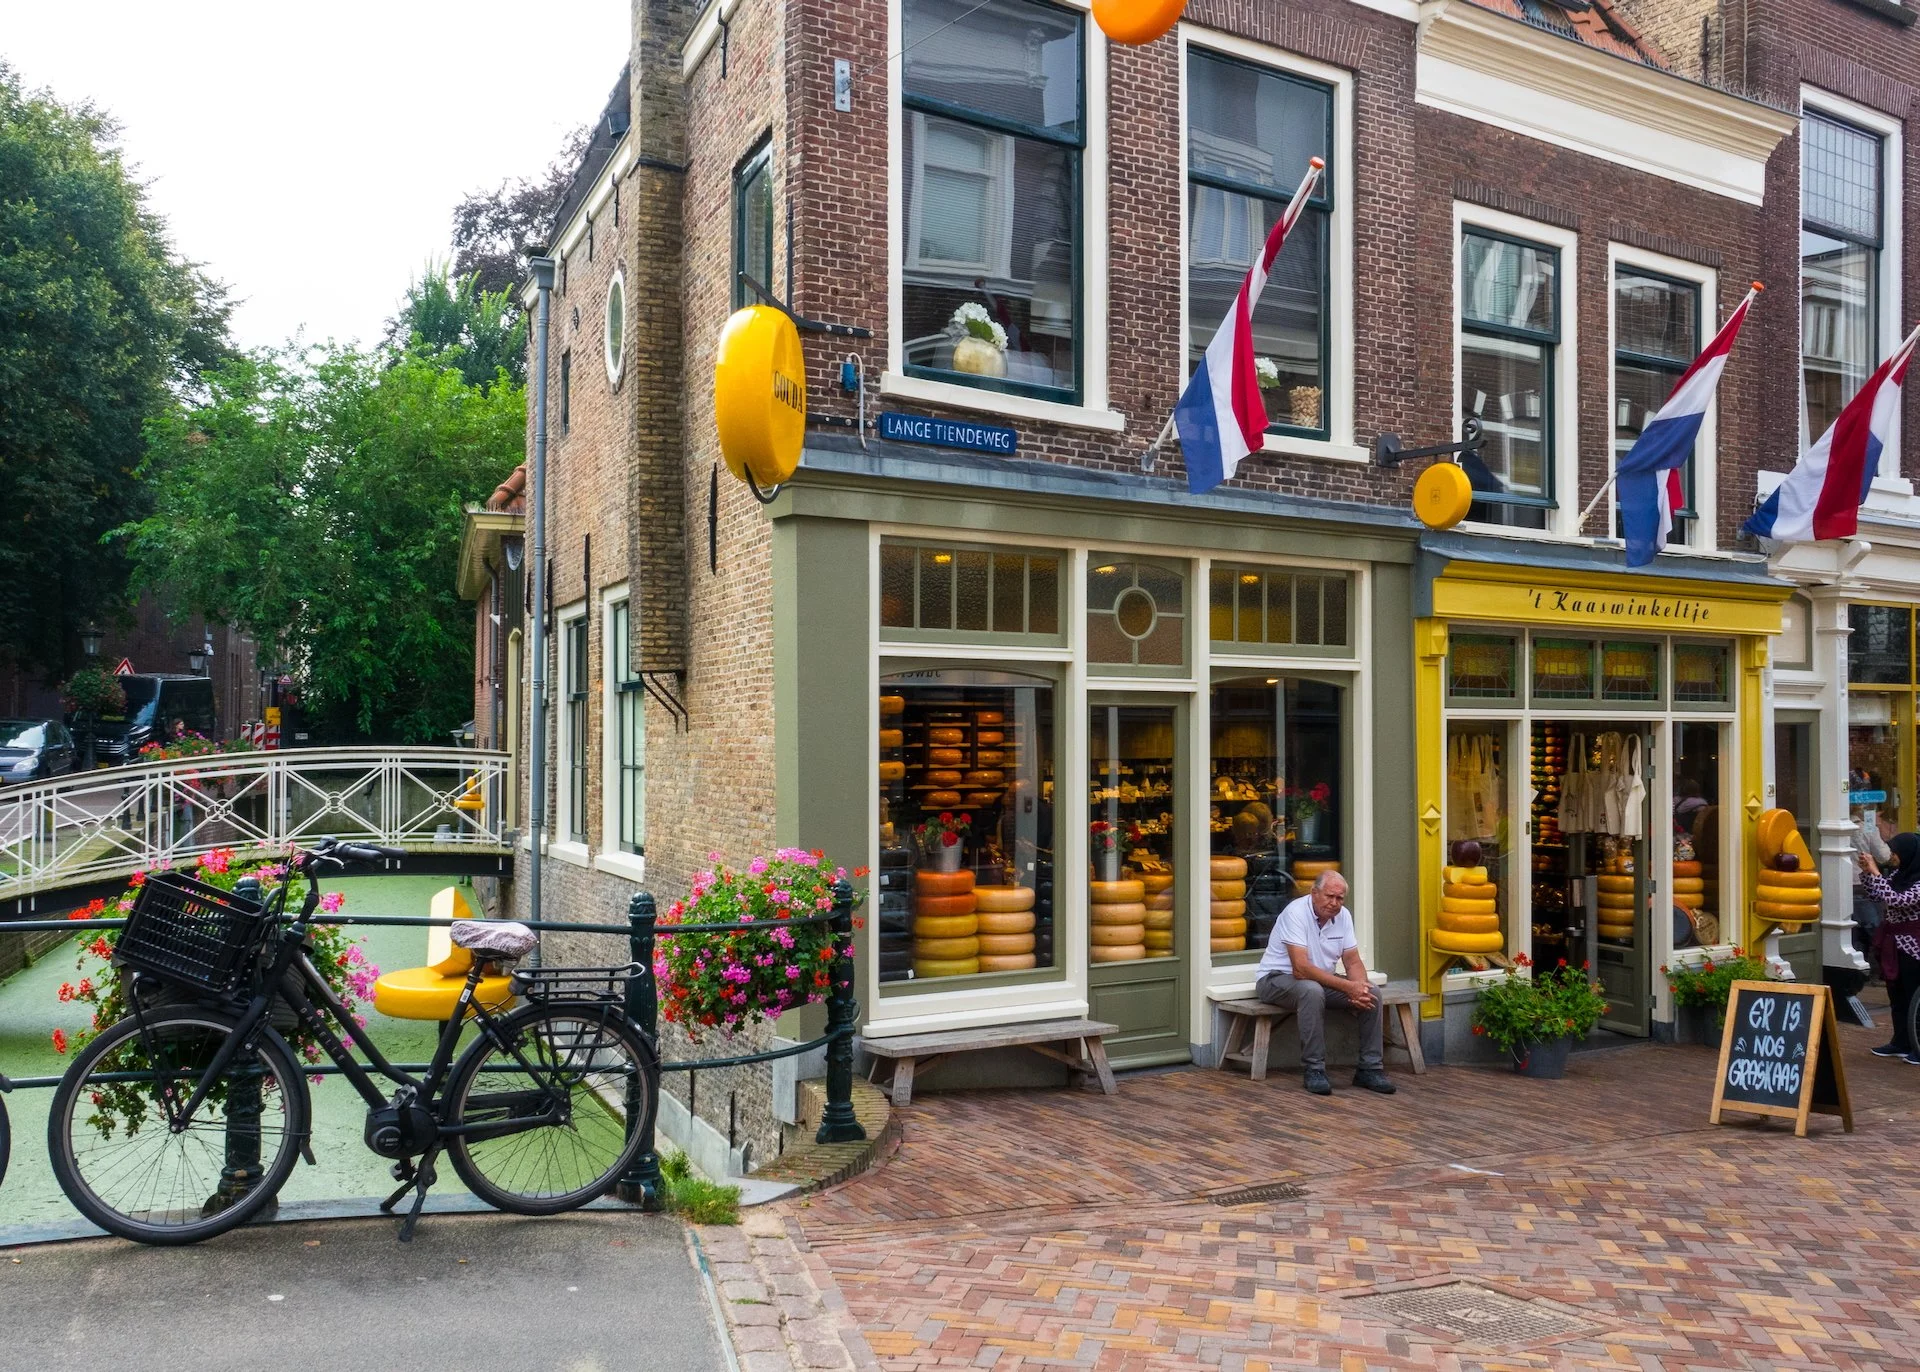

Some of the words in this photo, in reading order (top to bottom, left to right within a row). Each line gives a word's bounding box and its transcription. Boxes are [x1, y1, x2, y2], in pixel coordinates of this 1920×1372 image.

[774, 371, 803, 413] GOUDA
[888, 417, 931, 439] LANGE
[935, 424, 1010, 449] TIENDEWEG
[1528, 589, 1541, 609] 't
[1549, 590, 1710, 623] Kaaswinkeltje
[1749, 998, 1775, 1031] ER
[1782, 1001, 1801, 1031] IS
[1753, 1035, 1785, 1058] NOG
[1728, 1058, 1800, 1095] GRASKAAS
